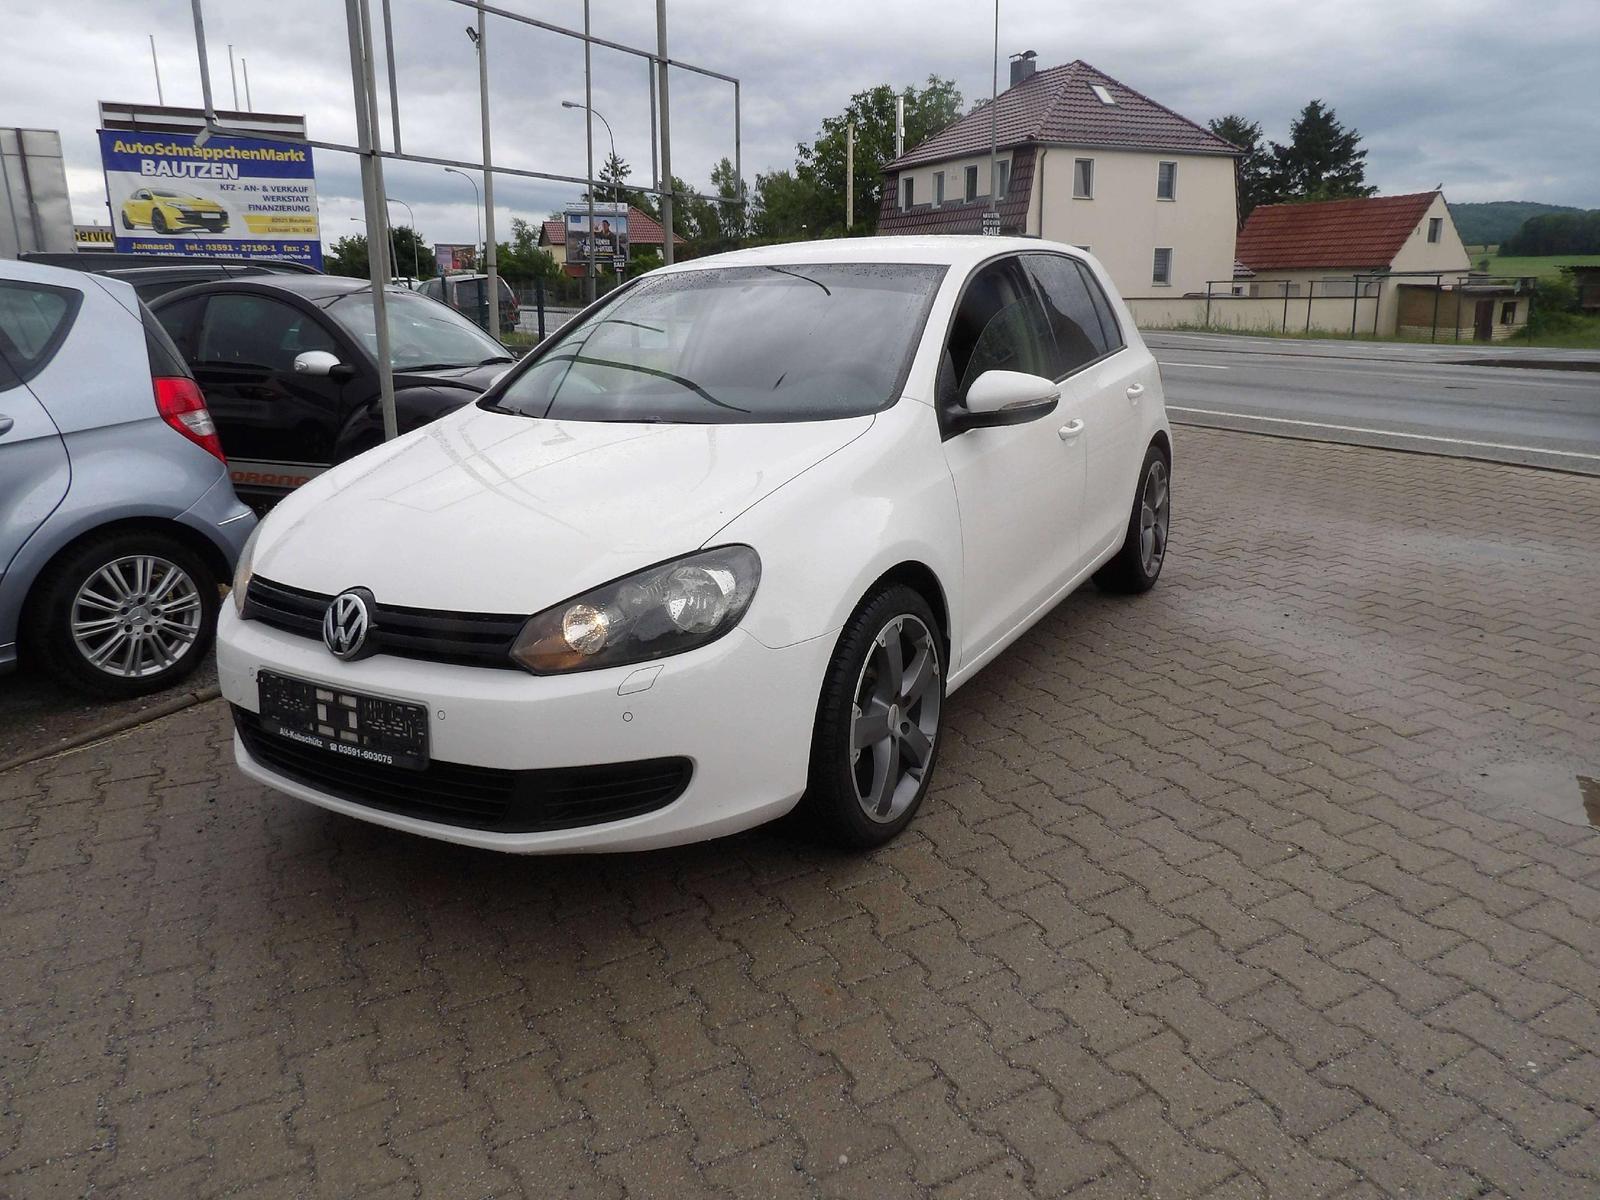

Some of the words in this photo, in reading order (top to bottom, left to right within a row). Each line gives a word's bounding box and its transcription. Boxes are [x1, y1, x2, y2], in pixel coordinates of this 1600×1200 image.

[141, 159, 240, 180] BAUTZEN
[220, 183, 236, 191] KFZ
[262, 195, 309, 203] WERKSTATT
[248, 204, 311, 212] FINANZIERUNG
[74, 228, 113, 242] Servic
[982, 226, 1001, 236] SALE
[131, 242, 175, 250] Jannasch
[338, 744, 393, 764] 03591-603075
